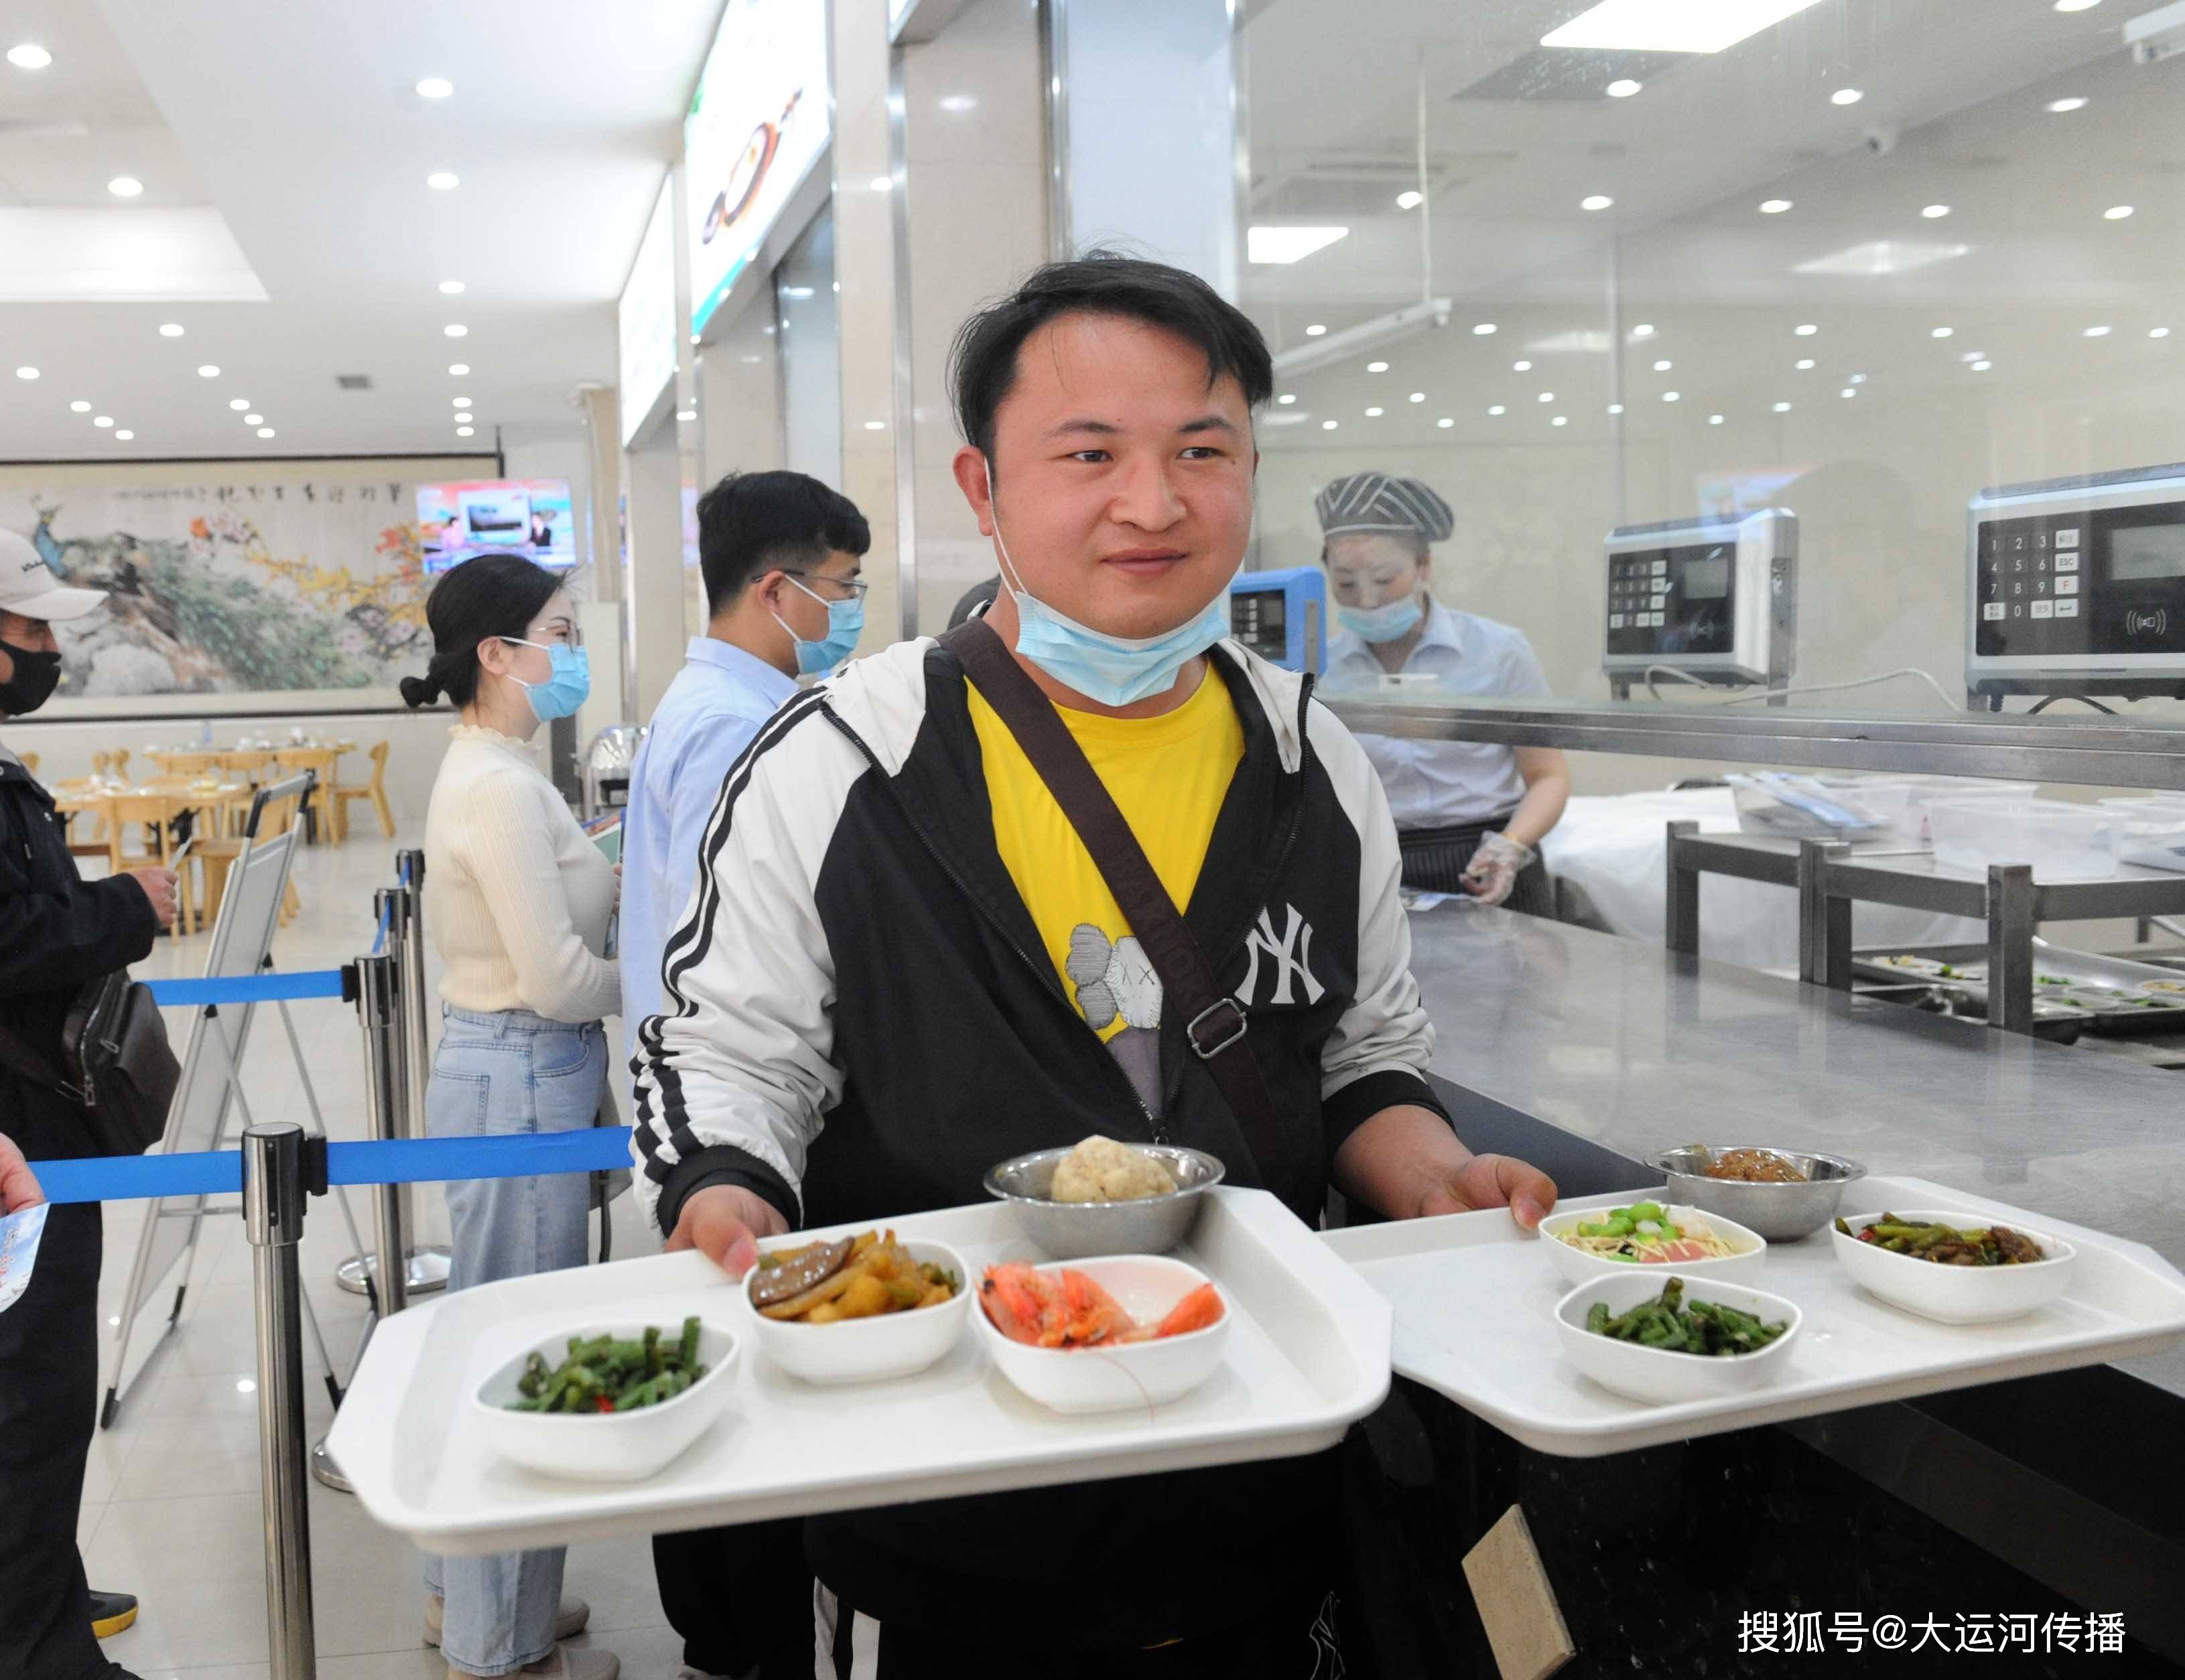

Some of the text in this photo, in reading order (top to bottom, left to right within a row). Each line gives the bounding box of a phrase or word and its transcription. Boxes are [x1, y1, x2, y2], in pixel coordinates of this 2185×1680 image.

[1992, 539, 1997, 551] 1
[2015, 537, 2022, 549] 2
[2039, 535, 2046, 548] 3
[1991, 557, 2074, 573] 4 5 6 ESC
[1991, 580, 2069, 595] 7 8 9 F
[2014, 605, 2022, 617] 0
[1234, 902, 1325, 1005] NY
